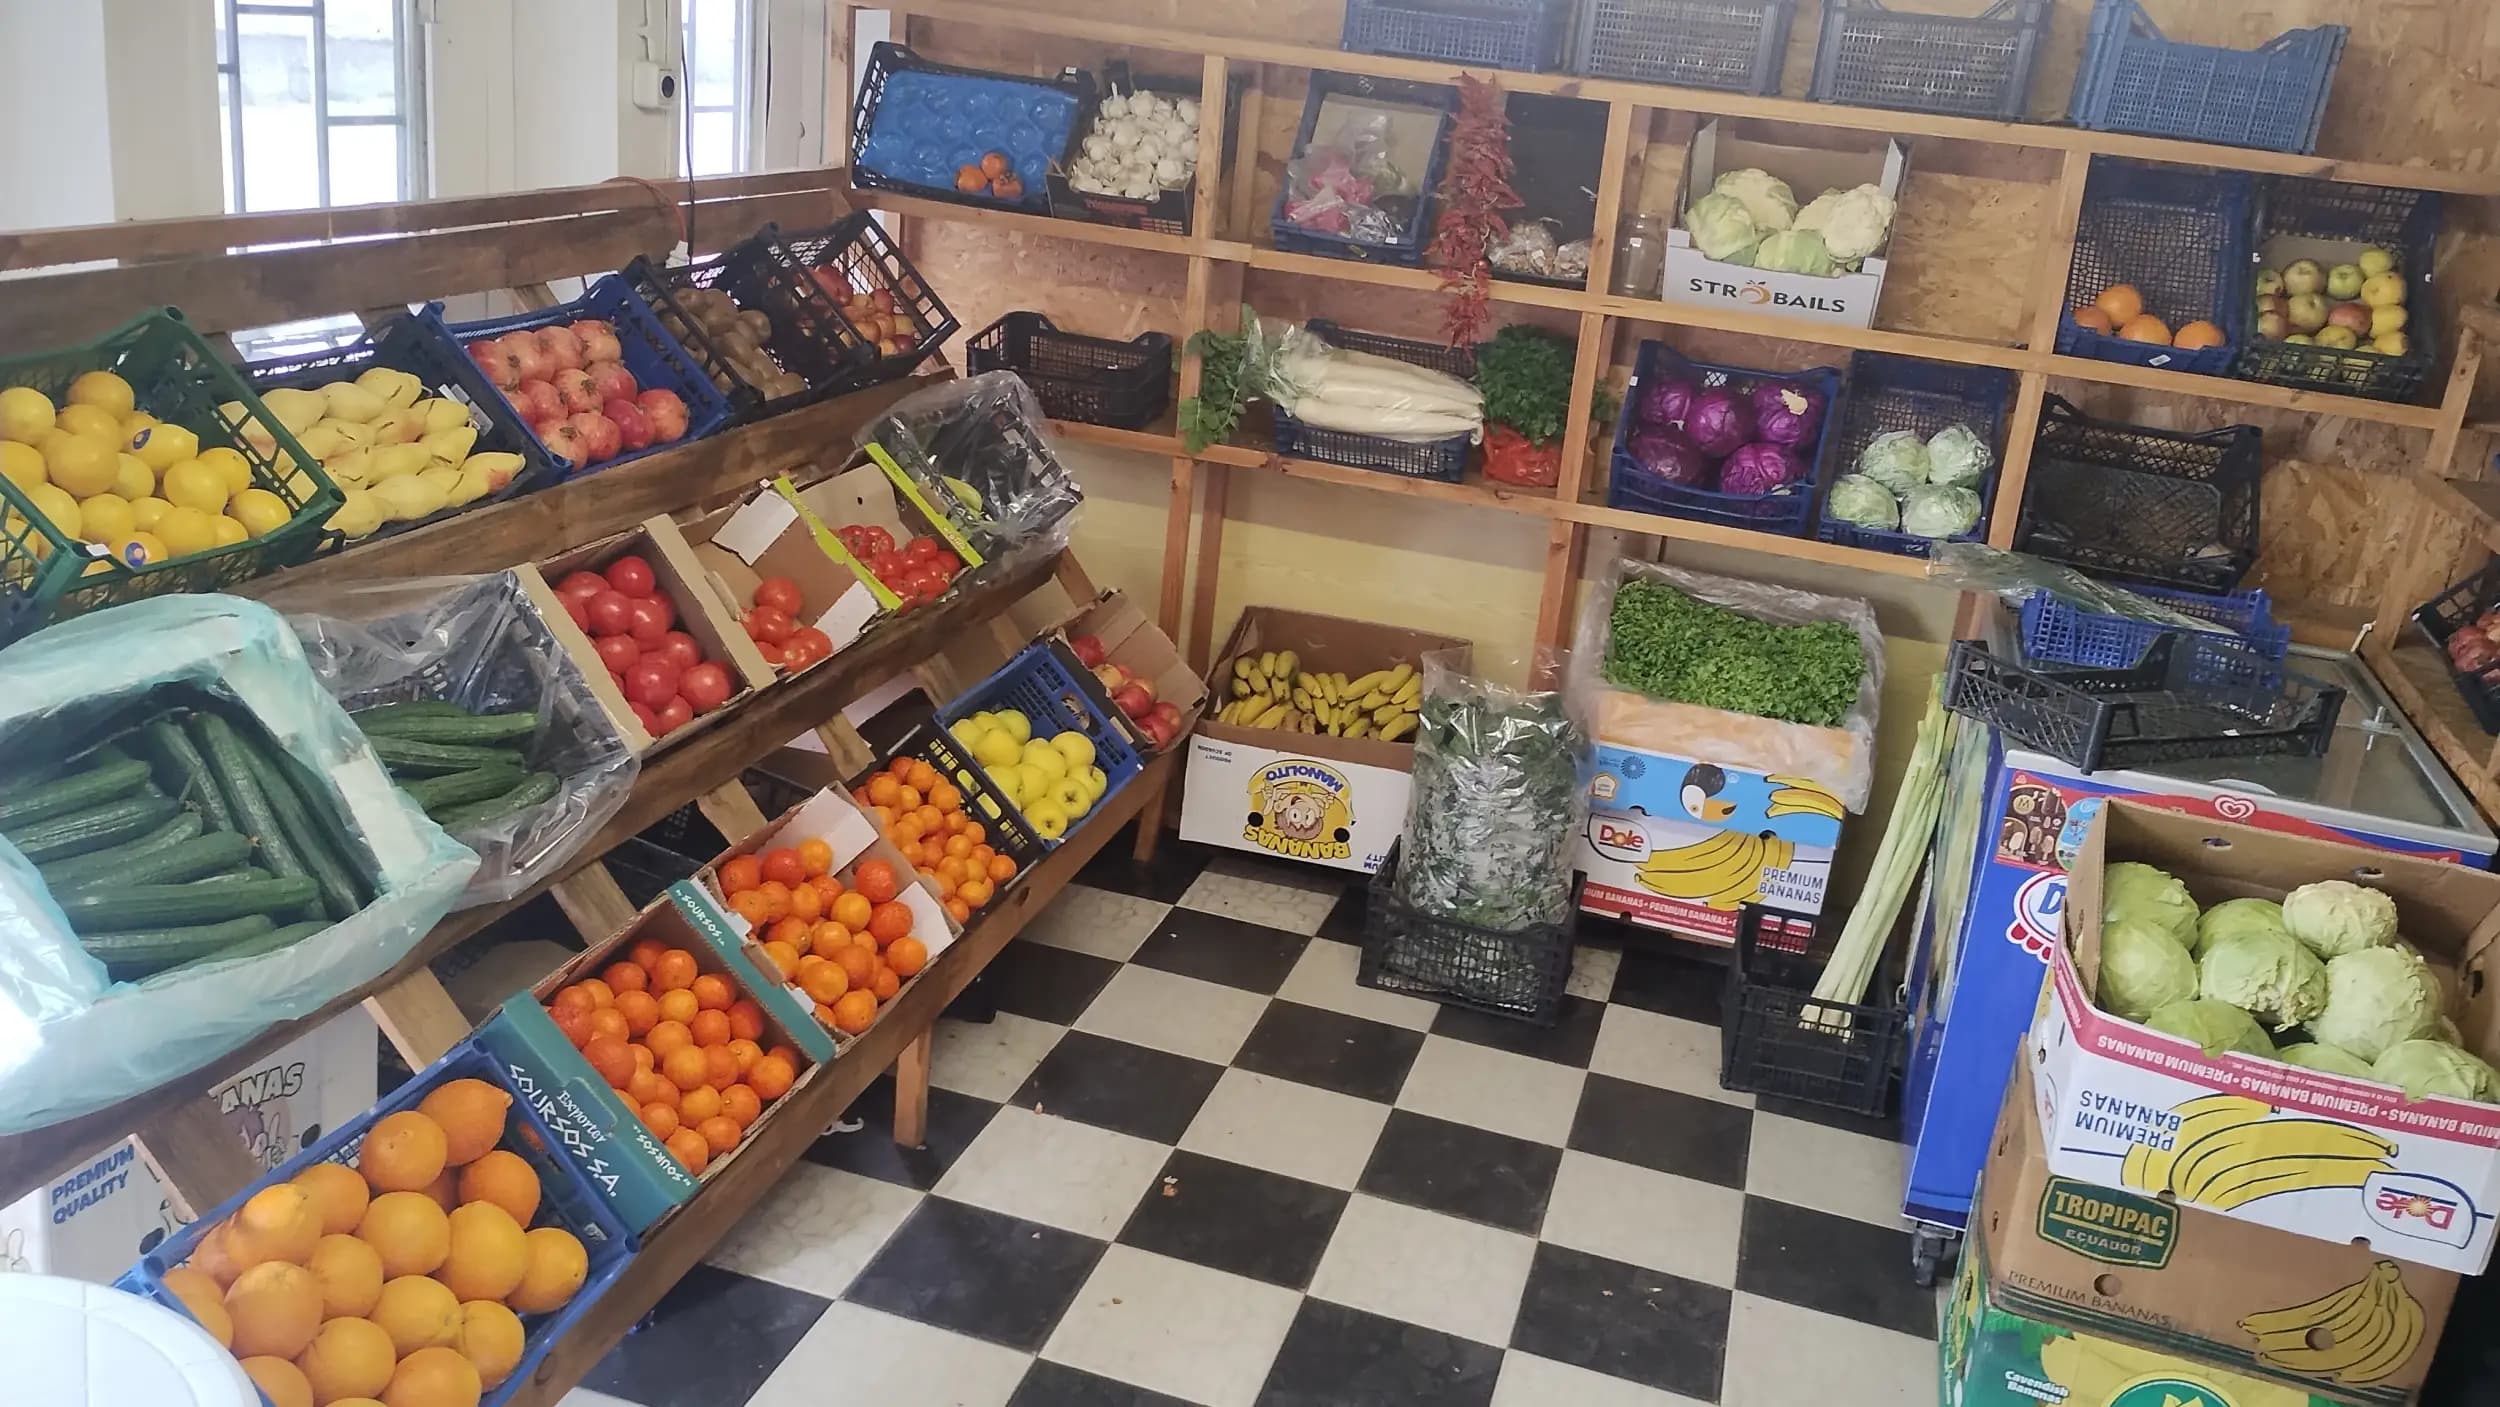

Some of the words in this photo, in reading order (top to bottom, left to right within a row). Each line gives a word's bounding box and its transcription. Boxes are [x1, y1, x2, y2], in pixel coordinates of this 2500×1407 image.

[1265, 765, 1344, 793] MANOLITO
[1243, 824, 1351, 860] BANANAS
[1600, 824, 1645, 848] Dole
[1759, 882, 1821, 905] BANANAS
[1762, 867, 1824, 890] PREMIUM
[682, 894, 723, 938] SOURSOS
[1604, 891, 1645, 909] BANANAS
[1649, 901, 1688, 920] PREMIUM
[1688, 909, 1728, 926] BANANAS
[2097, 1035, 2162, 1063] BANANAS
[2164, 1056, 2233, 1084] PREMIUM
[2241, 1076, 2307, 1102] BANANAS
[2310, 1094, 2379, 1117] PREMIUM
[557, 1090, 609, 1144] Exporter
[2080, 1090, 2181, 1131] BANANAS
[2388, 1109, 2456, 1131] BANANAS
[510, 1064, 594, 1158] SOURSOS
[587, 1158, 620, 1197] S.A.
[2075, 1111, 2175, 1151] PREMIUM
[51, 1144, 135, 1205] PREMIUM
[637, 1133, 686, 1182] SOURSOS
[53, 1170, 128, 1225] QUALITY
[2055, 1190, 2168, 1238] TROPIPAC
[2375, 1192, 2456, 1230] Dole
[2065, 1229, 2142, 1256] ECUADOR
[2008, 1270, 2085, 1303] PREMIUM
[2091, 1294, 2170, 1326] BANANAS
[2005, 1370, 2069, 1398] Cavendish
[2007, 1381, 2062, 1405] Bananas
